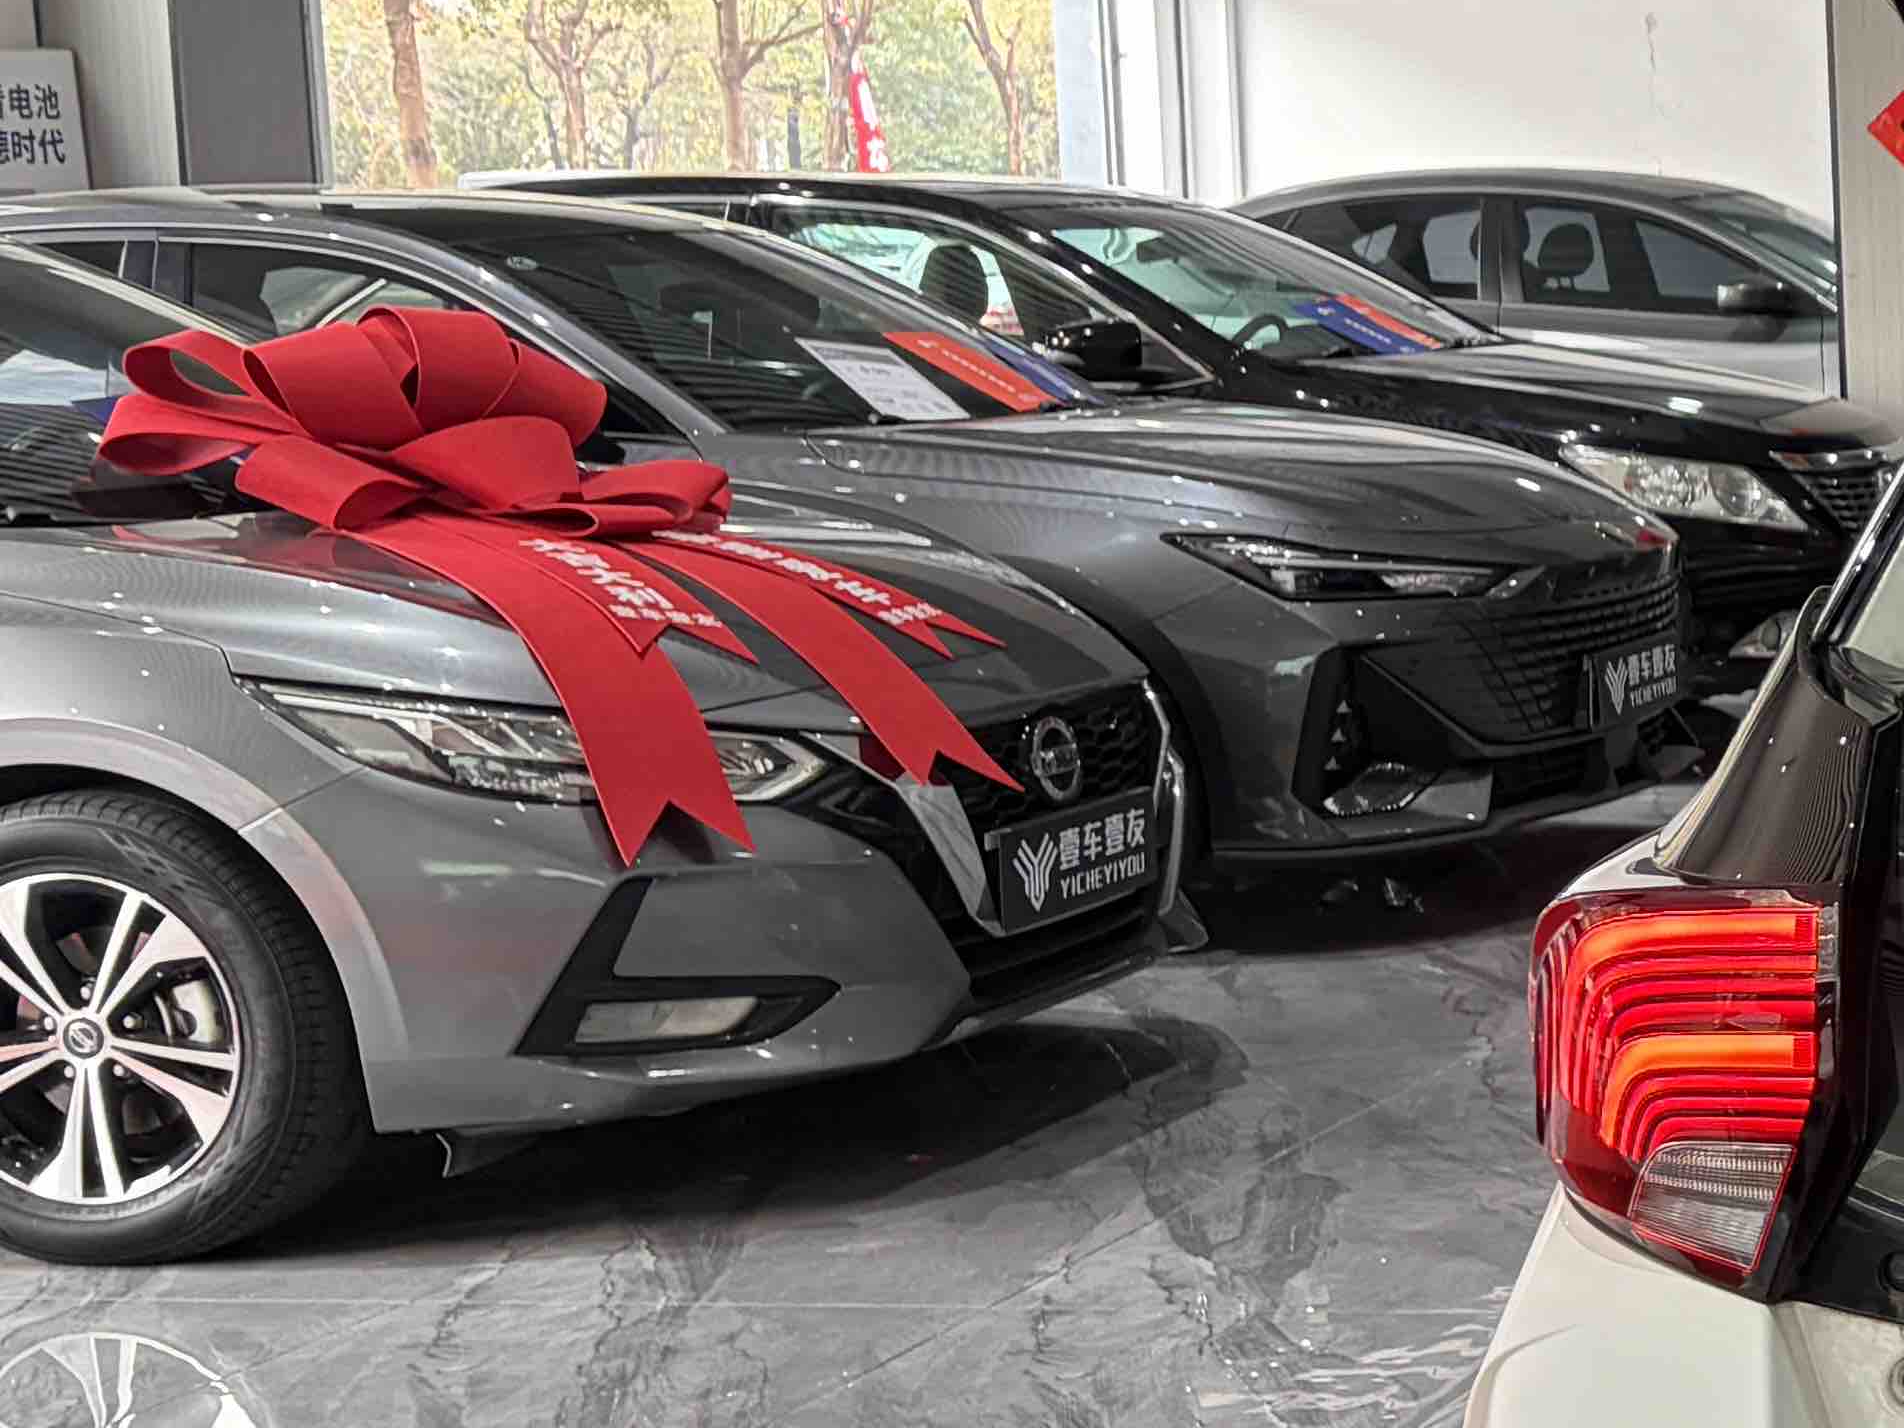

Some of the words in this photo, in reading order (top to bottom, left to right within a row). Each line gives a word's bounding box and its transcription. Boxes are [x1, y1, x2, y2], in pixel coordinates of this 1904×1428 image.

[0, 83, 61, 120] 电池
[1058, 808, 1146, 872] 壹车壹友
